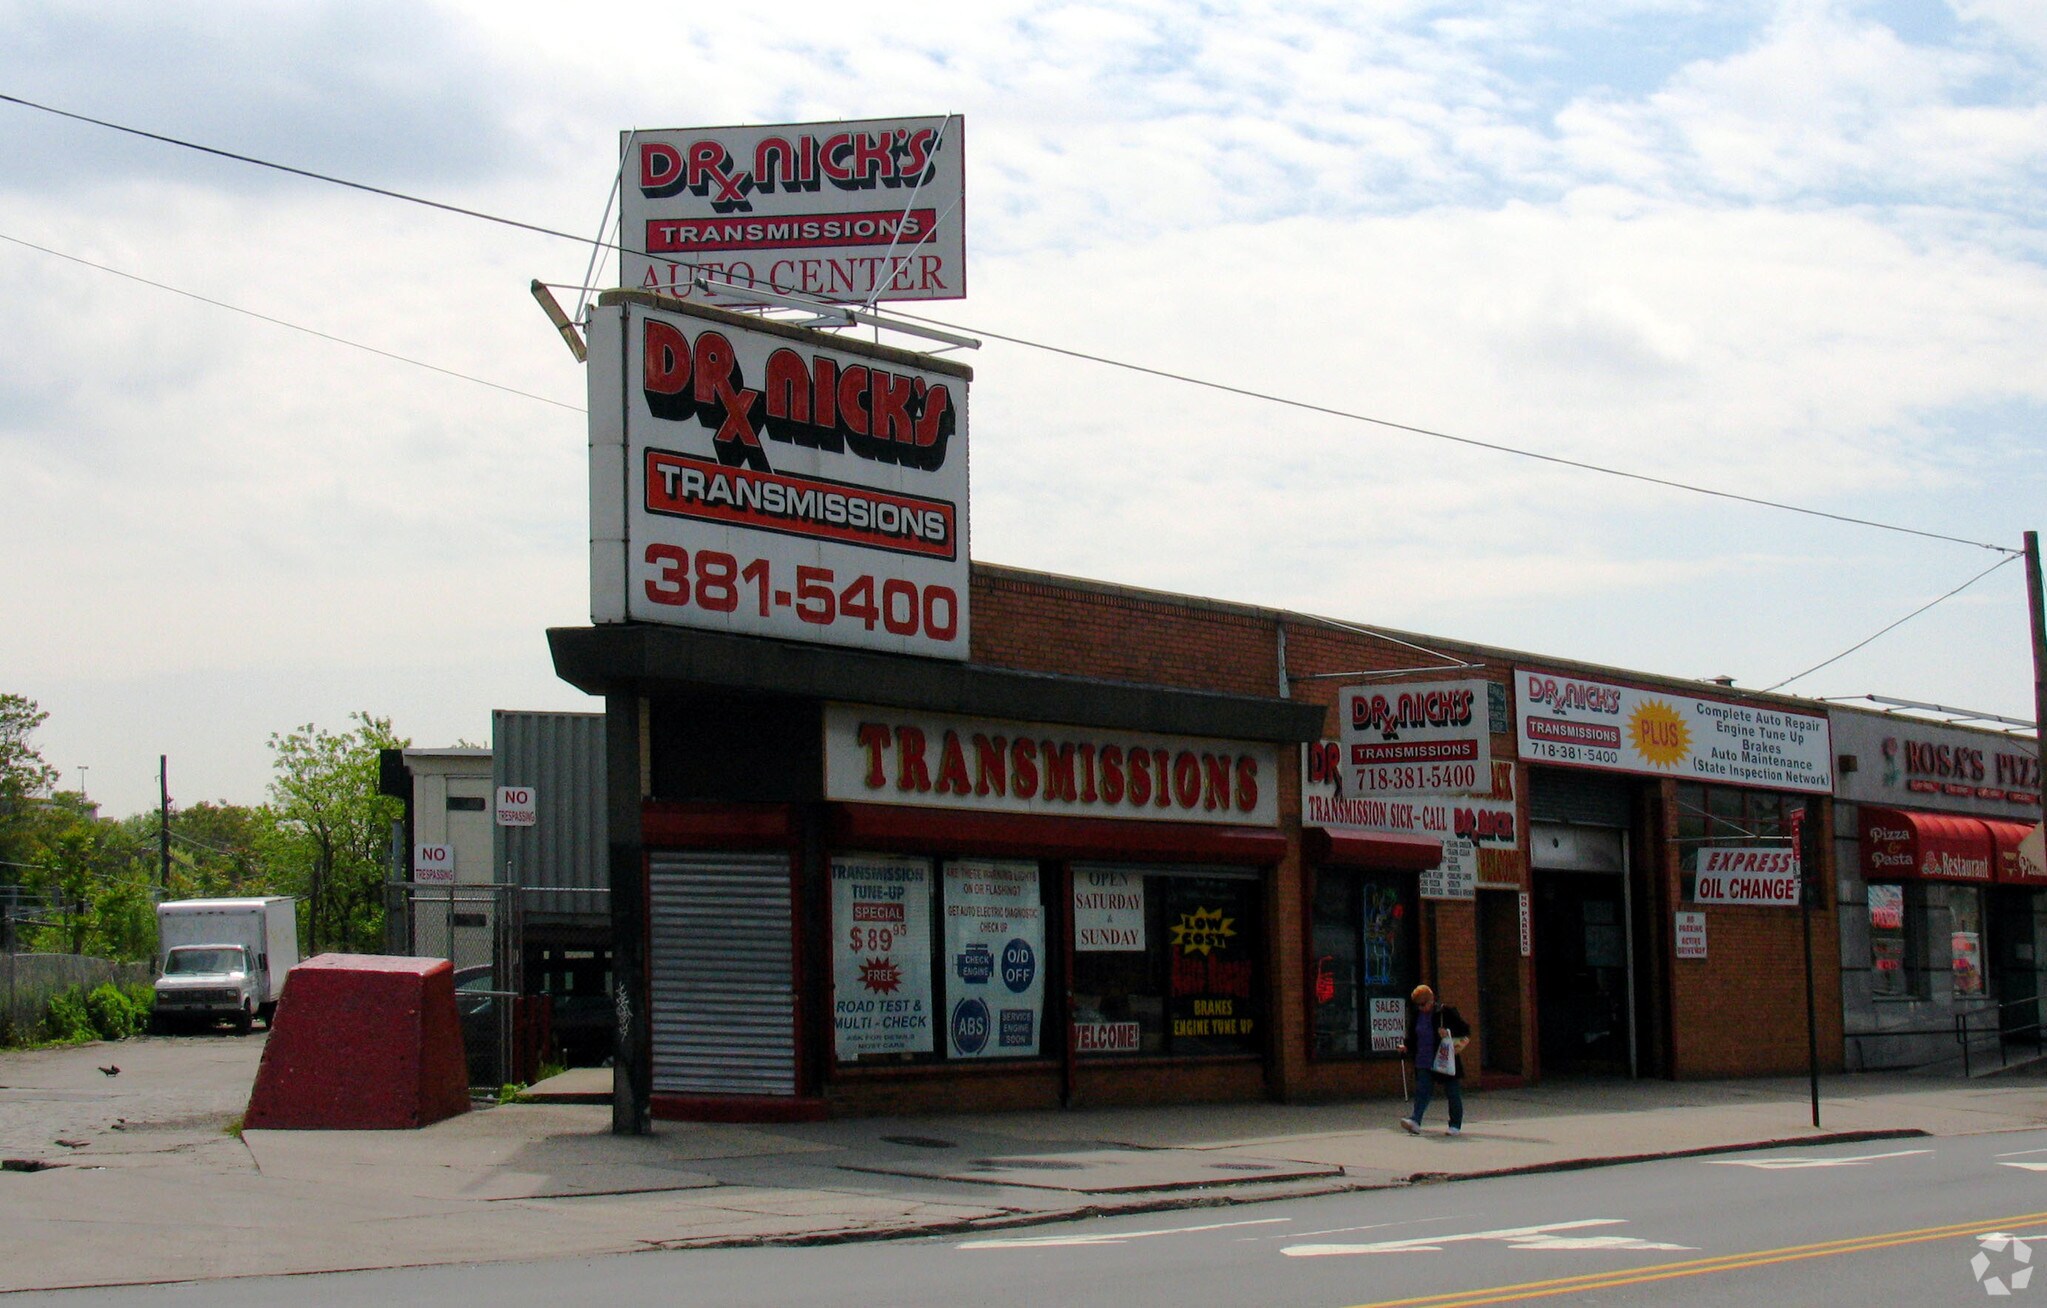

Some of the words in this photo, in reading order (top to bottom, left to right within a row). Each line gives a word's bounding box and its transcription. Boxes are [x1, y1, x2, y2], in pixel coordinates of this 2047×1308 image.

[754, 128, 941, 192] NICK'S
[659, 217, 921, 243] TRANSMISSIONS
[642, 261, 756, 298] AUTO
[769, 254, 948, 295] CENTER
[764, 347, 956, 472] NICK'S
[656, 462, 946, 541] TRANSMISSIONS
[644, 543, 957, 642] 381-5400
[1565, 682, 1621, 715] NICK'S
[1396, 689, 1475, 728] NICK'S
[1696, 703, 1752, 724] Complete
[1755, 711, 1781, 726] Auto
[1784, 715, 1821, 733] Repair
[1529, 721, 1617, 743] TRANSMISSIONS
[1640, 719, 1679, 748] PLUS
[1716, 721, 1755, 741] Engine
[1758, 726, 1786, 742] Tune
[1789, 731, 1805, 746] Up
[1357, 744, 1471, 760] TRANSMISSIONS
[1531, 742, 1618, 764] 718-381-5400
[1742, 738, 1782, 755] Brakes
[858, 721, 1259, 813] TRANSMISSIONS
[1711, 746, 1737, 762] Auto
[1740, 750, 1813, 771] Maintenance
[1904, 739, 1985, 782] ROSA'S
[1356, 764, 1476, 791] 718-381-5400
[1692, 756, 1726, 775] (State
[1729, 764, 1783, 784] Inspection
[1785, 769, 1830, 787] Network)
[505, 790, 529, 804] NO
[498, 810, 536, 822] TRESPASSING
[1308, 796, 1387, 826] TRANSMISSION
[1390, 802, 1448, 831] SICK-CALL
[1869, 826, 1911, 844] Pizza
[422, 848, 446, 861] NO
[1888, 841, 1901, 855] &
[1706, 852, 1792, 873] EXPRESS
[1871, 851, 1914, 869] Pasta
[1941, 852, 1989, 879] Restaurant
[415, 868, 453, 880] TRESPASSING
[831, 863, 924, 882] TRANSMISSION
[1089, 872, 1129, 887] OPEN
[851, 884, 905, 901] TUNE-UP
[1699, 878, 1725, 899] OIL
[1729, 878, 1794, 900] CHANGE
[1075, 893, 1142, 911] SATURDAY
[1521, 895, 1528, 907] NO
[854, 906, 903, 920] SPECIAL
[979, 921, 999, 933] CHECK
[999, 922, 1009, 933] UP
[1184, 916, 1222, 932] LOW
[1081, 929, 1140, 946] SUNDAY
[1182, 932, 1227, 948] COST
[965, 955, 990, 964] CHECK
[1007, 949, 1029, 963] O/D
[867, 969, 894, 982] FREE
[963, 966, 990, 977] ENGINE
[1006, 968, 1030, 982] OFF
[836, 1000, 875, 1014] ROAD
[879, 999, 911, 1013] TEST
[913, 999, 922, 1012] &
[1193, 999, 1233, 1016] BRAKES
[1375, 1000, 1400, 1013] SALES
[834, 1016, 872, 1030] MULTI
[882, 1015, 927, 1029] CHECK
[1002, 1011, 1032, 1022] SERVICE
[1373, 1018, 1404, 1031] PERSON
[958, 1016, 985, 1036] ABS
[1003, 1023, 1030, 1033] ENGINE
[1174, 1018, 1210, 1037] ENGINE
[1211, 1018, 1237, 1036] TUNE
[1239, 1018, 1254, 1035] UP
[1006, 1035, 1026, 1044] SOON
